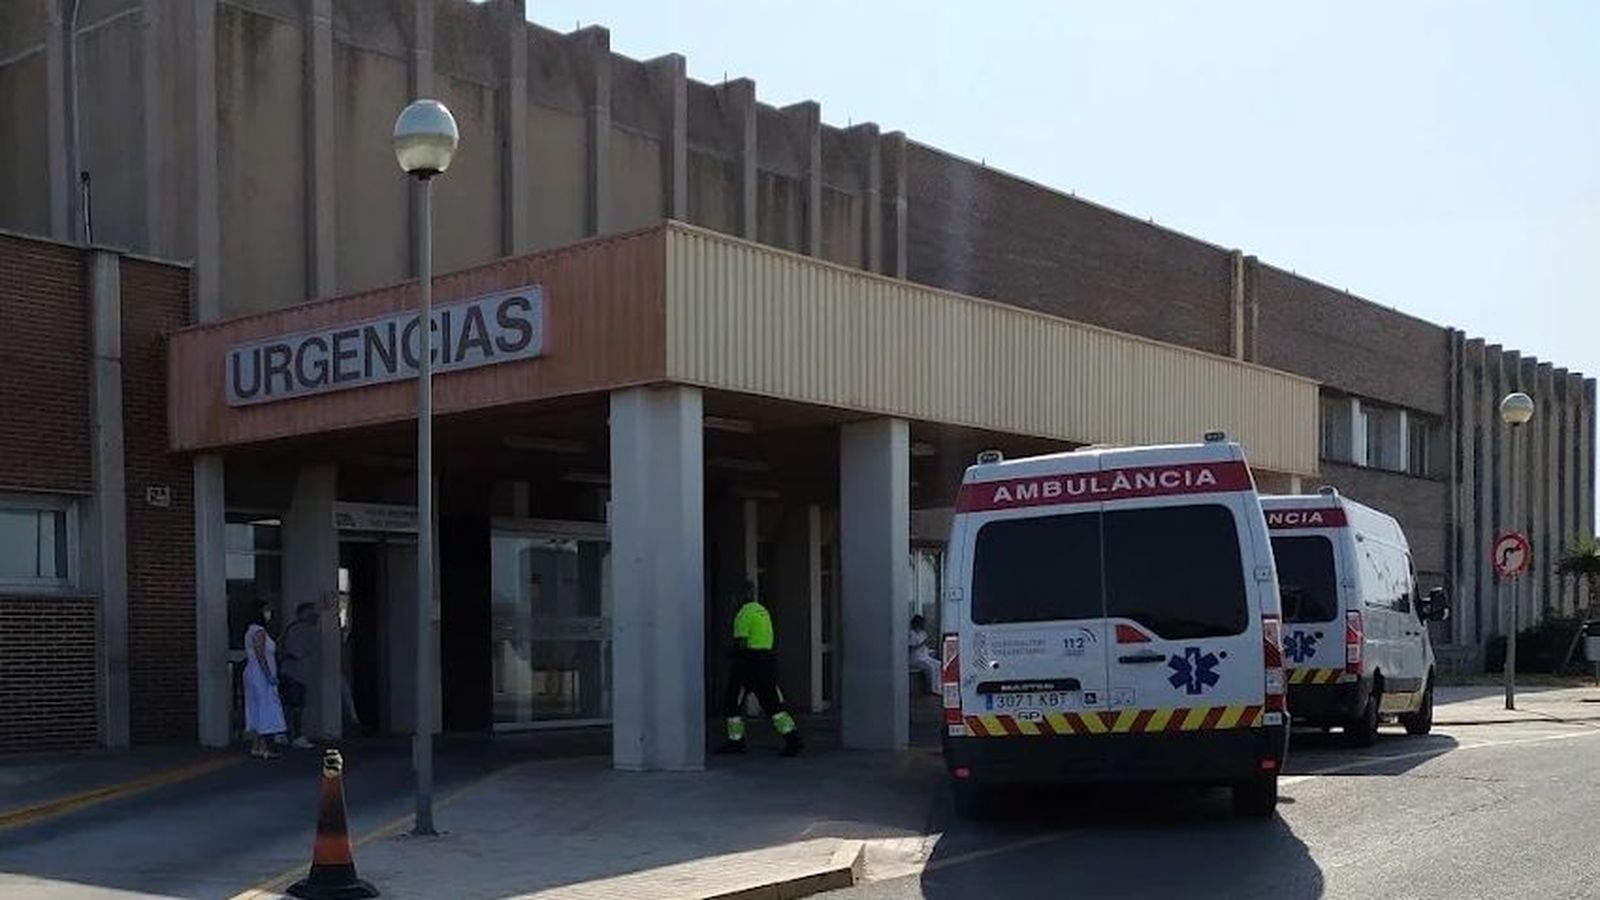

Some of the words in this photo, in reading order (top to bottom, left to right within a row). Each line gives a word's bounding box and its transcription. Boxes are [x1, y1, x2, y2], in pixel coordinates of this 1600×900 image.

[233, 296, 533, 398] URGENCIAS
[993, 467, 1218, 503] AMBULÀNCIA
[1268, 511, 1324, 525] NCIA
[1063, 638, 1085, 648] 112
[996, 694, 1034, 709] 3071
